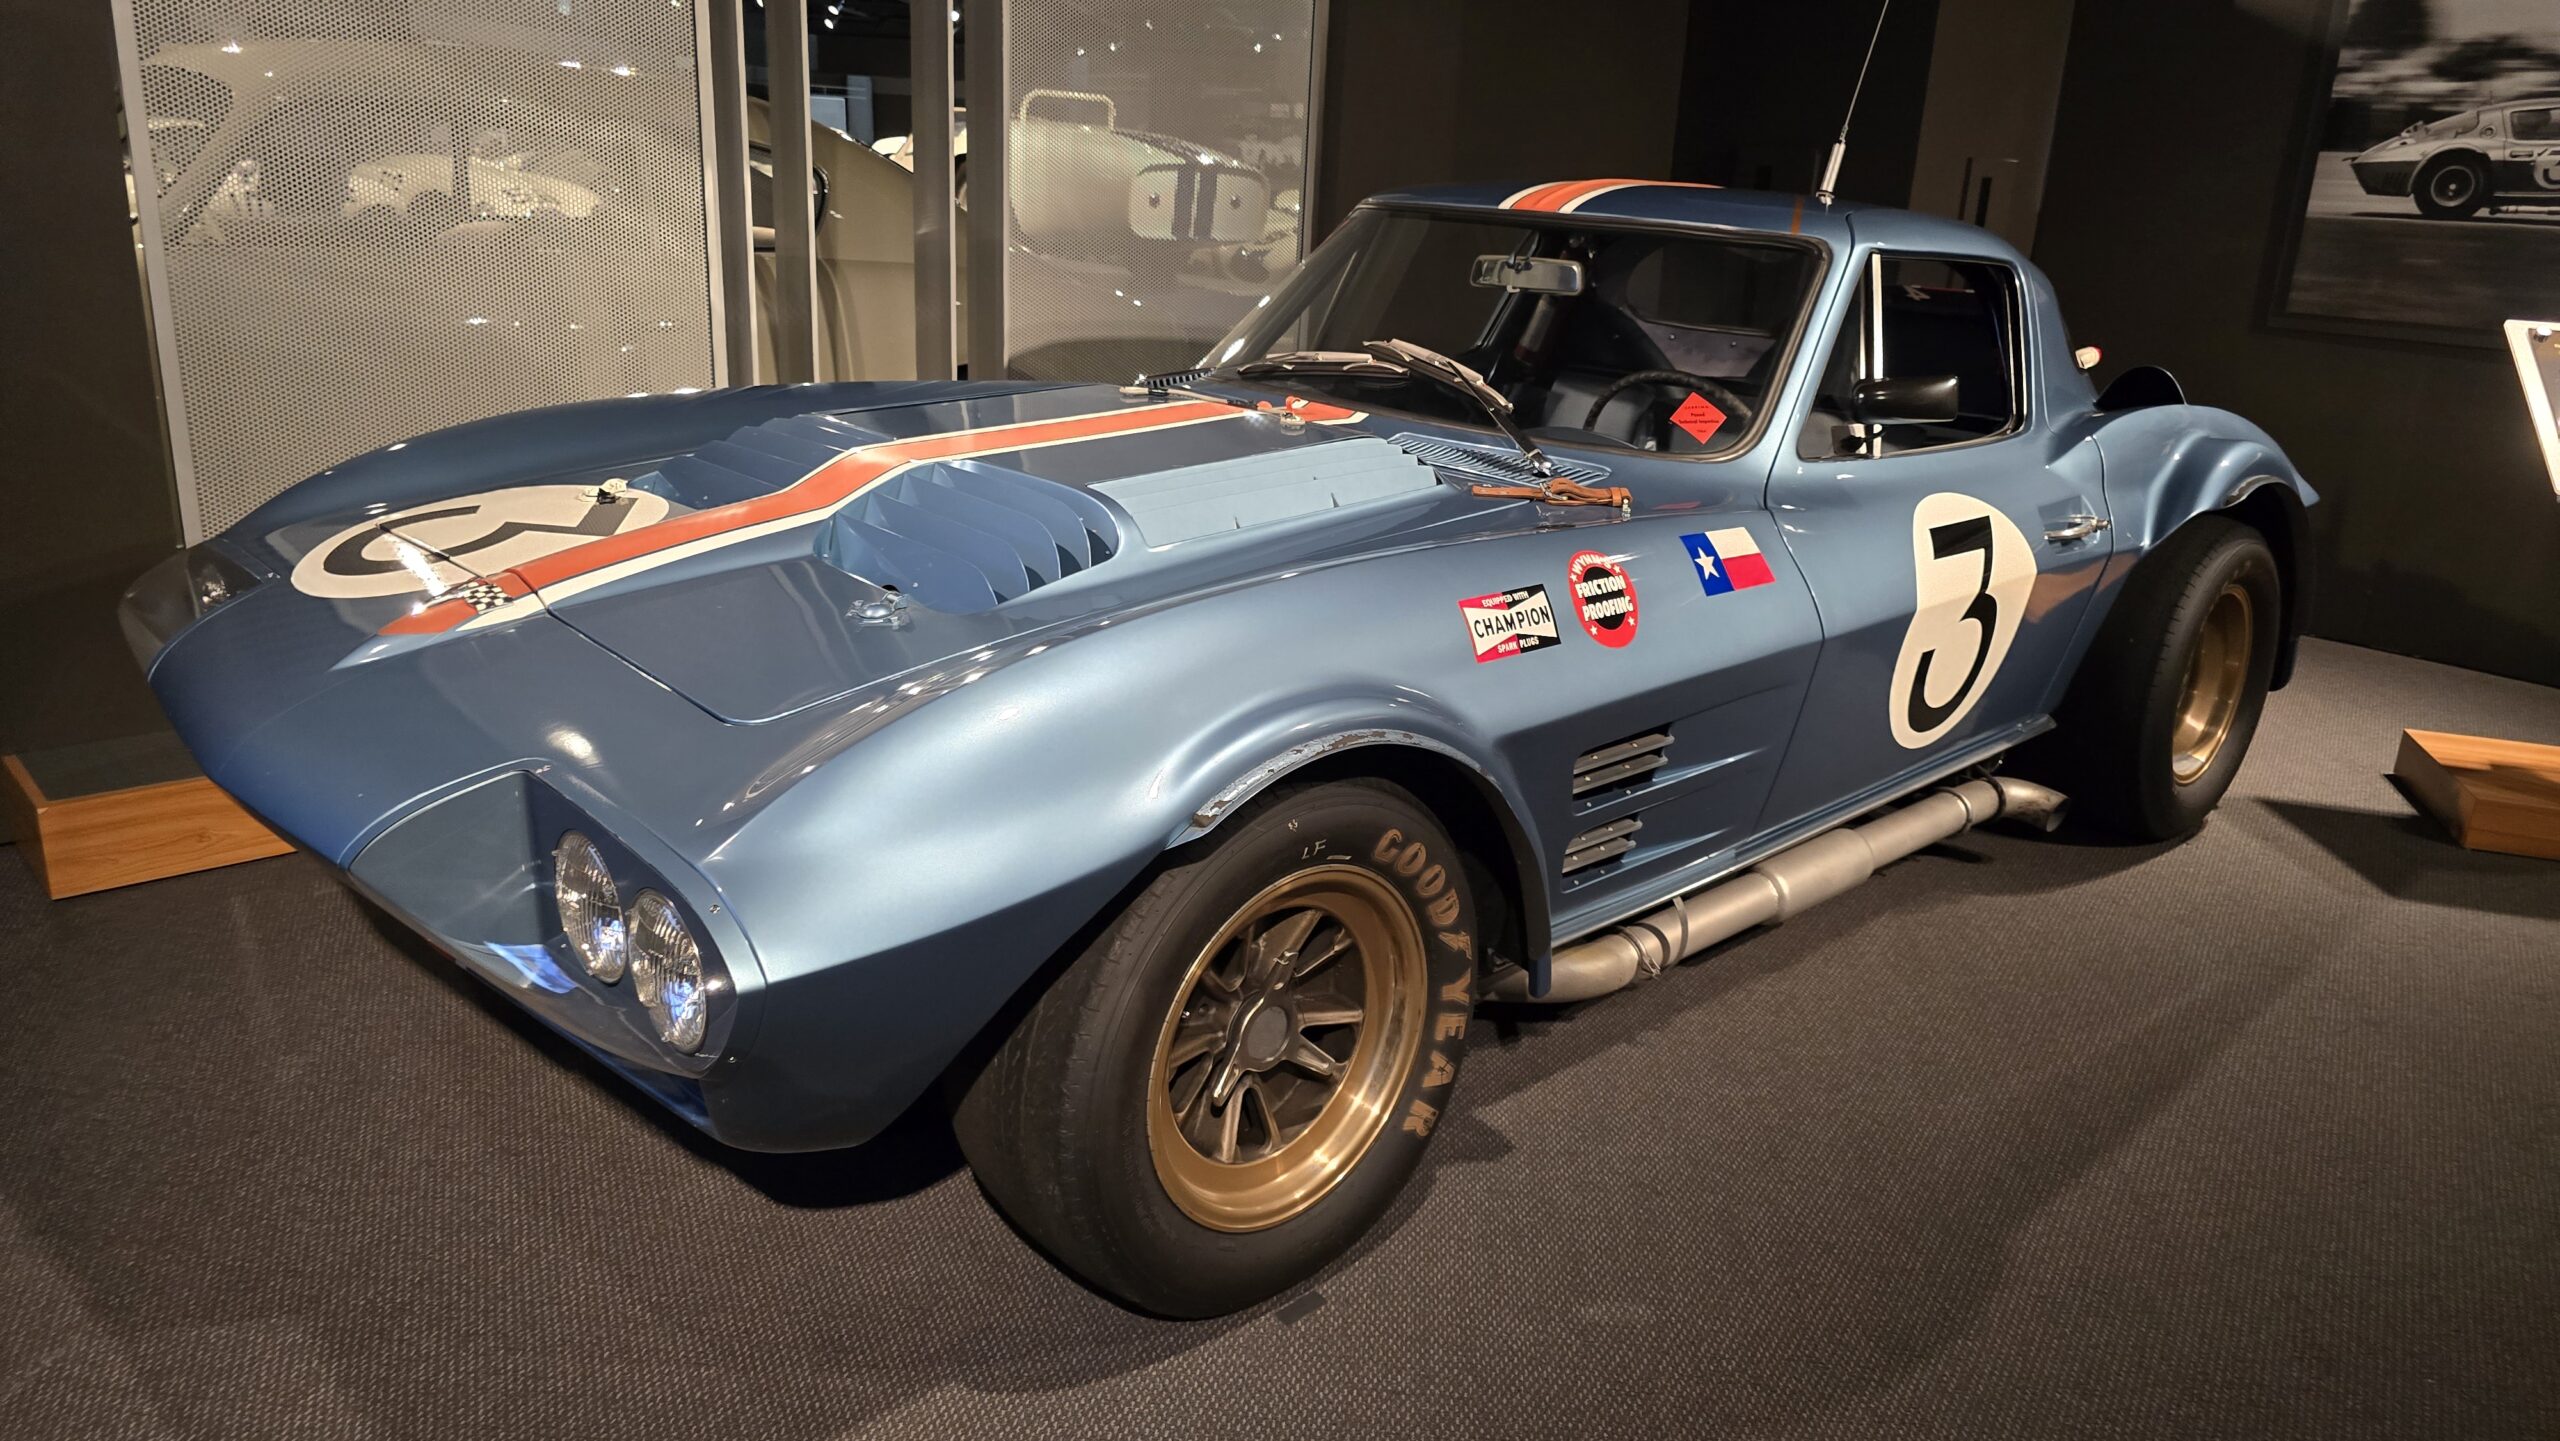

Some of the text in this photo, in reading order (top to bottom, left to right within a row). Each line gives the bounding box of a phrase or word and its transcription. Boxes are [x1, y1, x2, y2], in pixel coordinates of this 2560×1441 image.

[1481, 590, 1529, 607] EQUIPPED WITH
[1575, 575, 1627, 599] FRICTION
[1582, 595, 1633, 621] PROOFING
[1473, 605, 1551, 638] CHAMPION
[1907, 515, 1998, 733] 3
[1497, 636, 1539, 653] SPARK PLUGS
